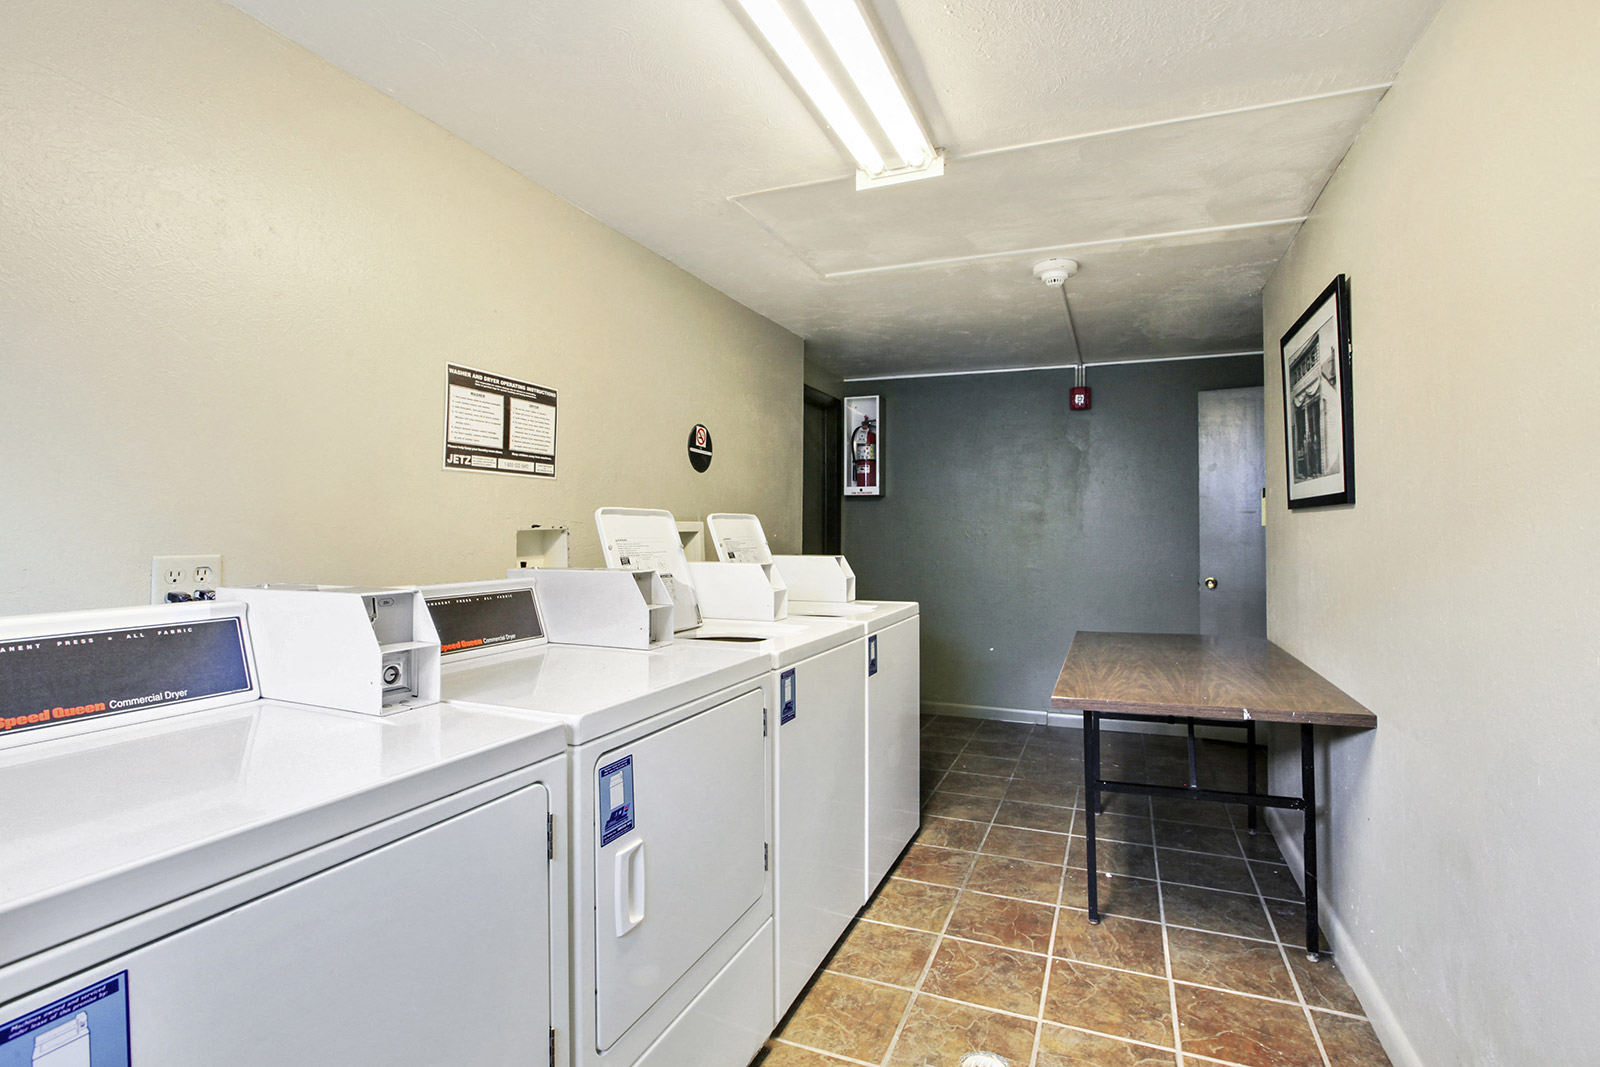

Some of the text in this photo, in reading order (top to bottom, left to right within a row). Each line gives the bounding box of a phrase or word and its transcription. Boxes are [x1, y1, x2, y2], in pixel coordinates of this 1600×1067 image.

[449, 367, 472, 379] WASHER
[472, 373, 483, 381] AND
[483, 375, 500, 385] DRYER
[500, 379, 526, 391] OPERATING
[526, 386, 557, 398] INSTRUCTIONS
[446, 453, 472, 466] JETZ
[56, 637, 94, 647] PRESS
[126, 632, 145, 640] ALL
[157, 627, 194, 636] FABRIC
[461, 637, 484, 648] Queen
[483, 634, 506, 645] Commercial
[505, 634, 516, 642] Dryer
[52, 702, 106, 719] Queen
[109, 692, 163, 710] Commercial
[164, 688, 188, 701] Dryer
[8, 1027, 29, 1040] under
[30, 1018, 48, 1029] lease
[49, 1013, 57, 1021] of
[59, 1008, 71, 1016] this
[72, 996, 97, 1011] premise
[10, 985, 106, 1032] Machines owned and serviced
